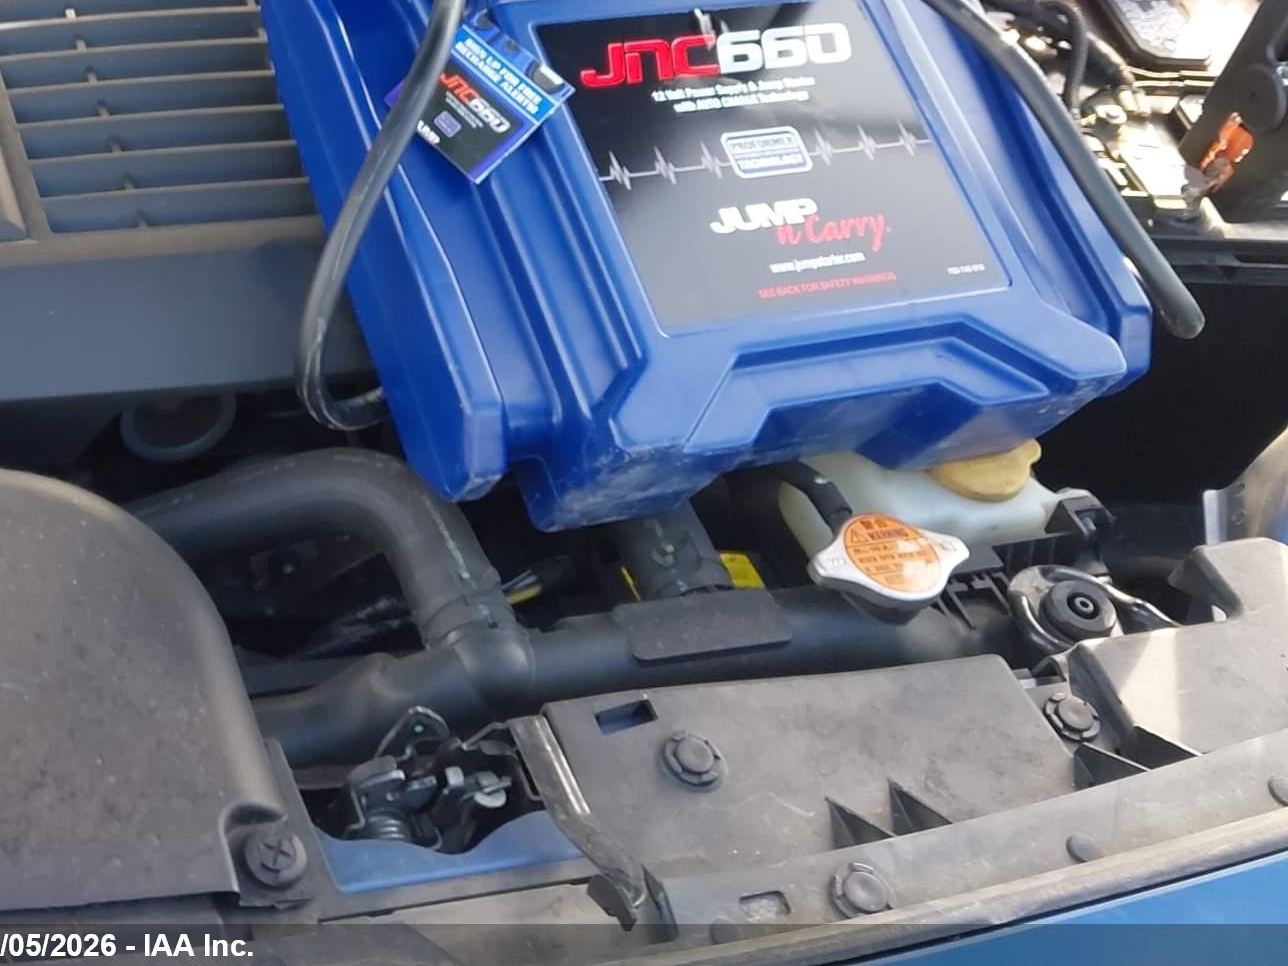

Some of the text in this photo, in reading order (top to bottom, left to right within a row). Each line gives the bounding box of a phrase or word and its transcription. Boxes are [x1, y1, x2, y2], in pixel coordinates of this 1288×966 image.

[580, 22, 852, 88] JNC660
[440, 72, 511, 134] JNC660
[709, 197, 818, 234] JUMP
